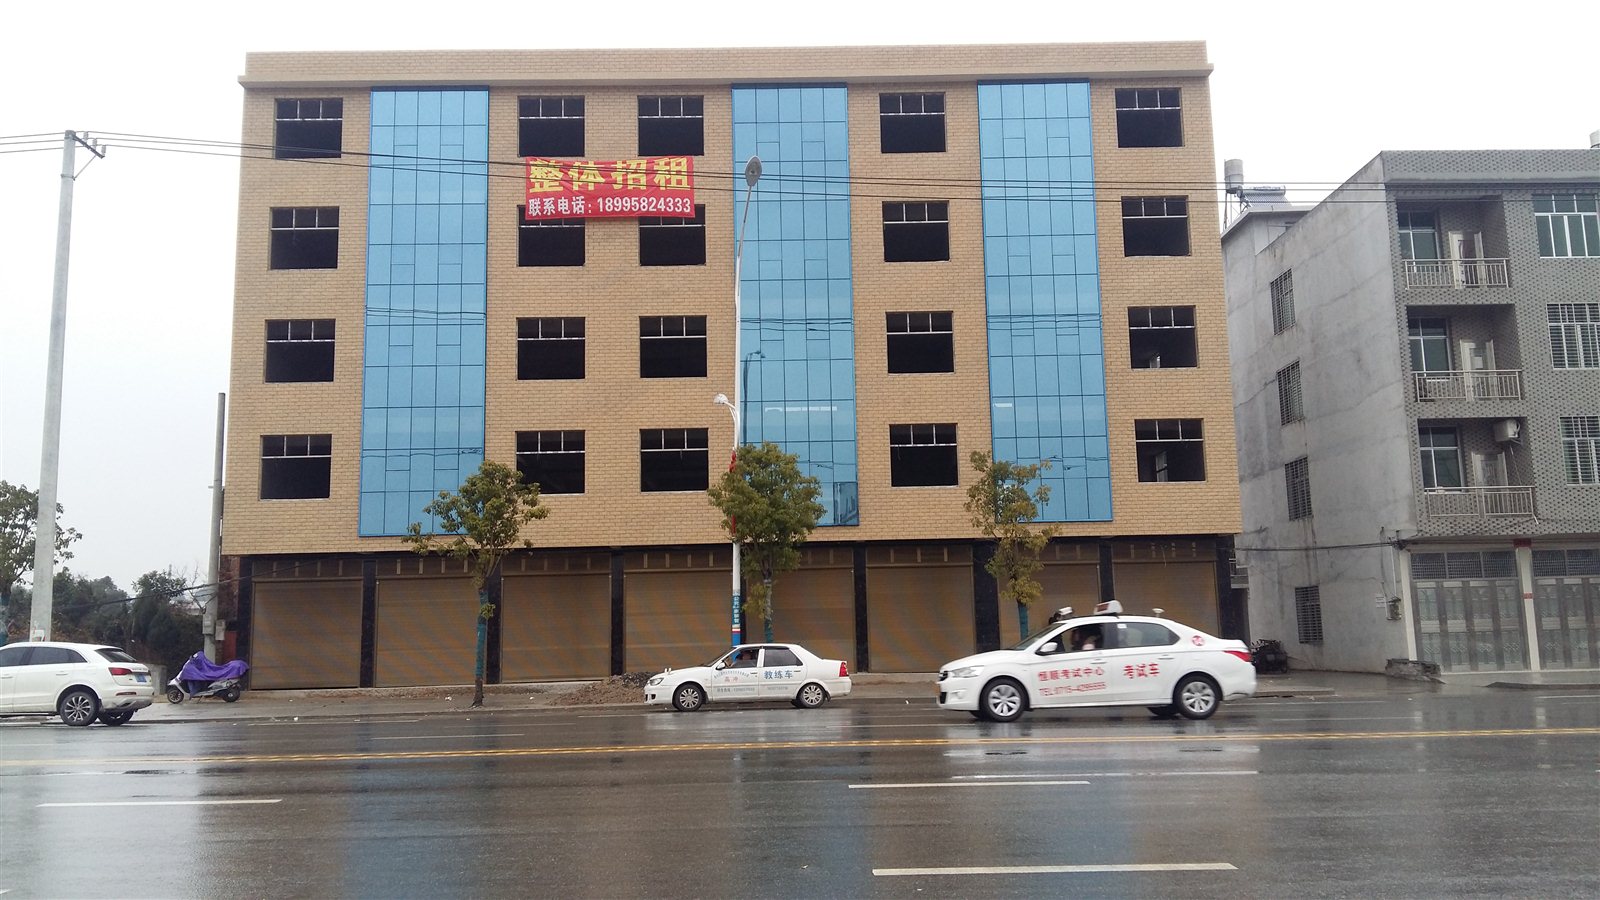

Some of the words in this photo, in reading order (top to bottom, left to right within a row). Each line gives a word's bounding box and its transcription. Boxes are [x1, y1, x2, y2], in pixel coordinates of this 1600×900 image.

[529, 158, 691, 193] 整体招租
[763, 669, 794, 680] 教练车
